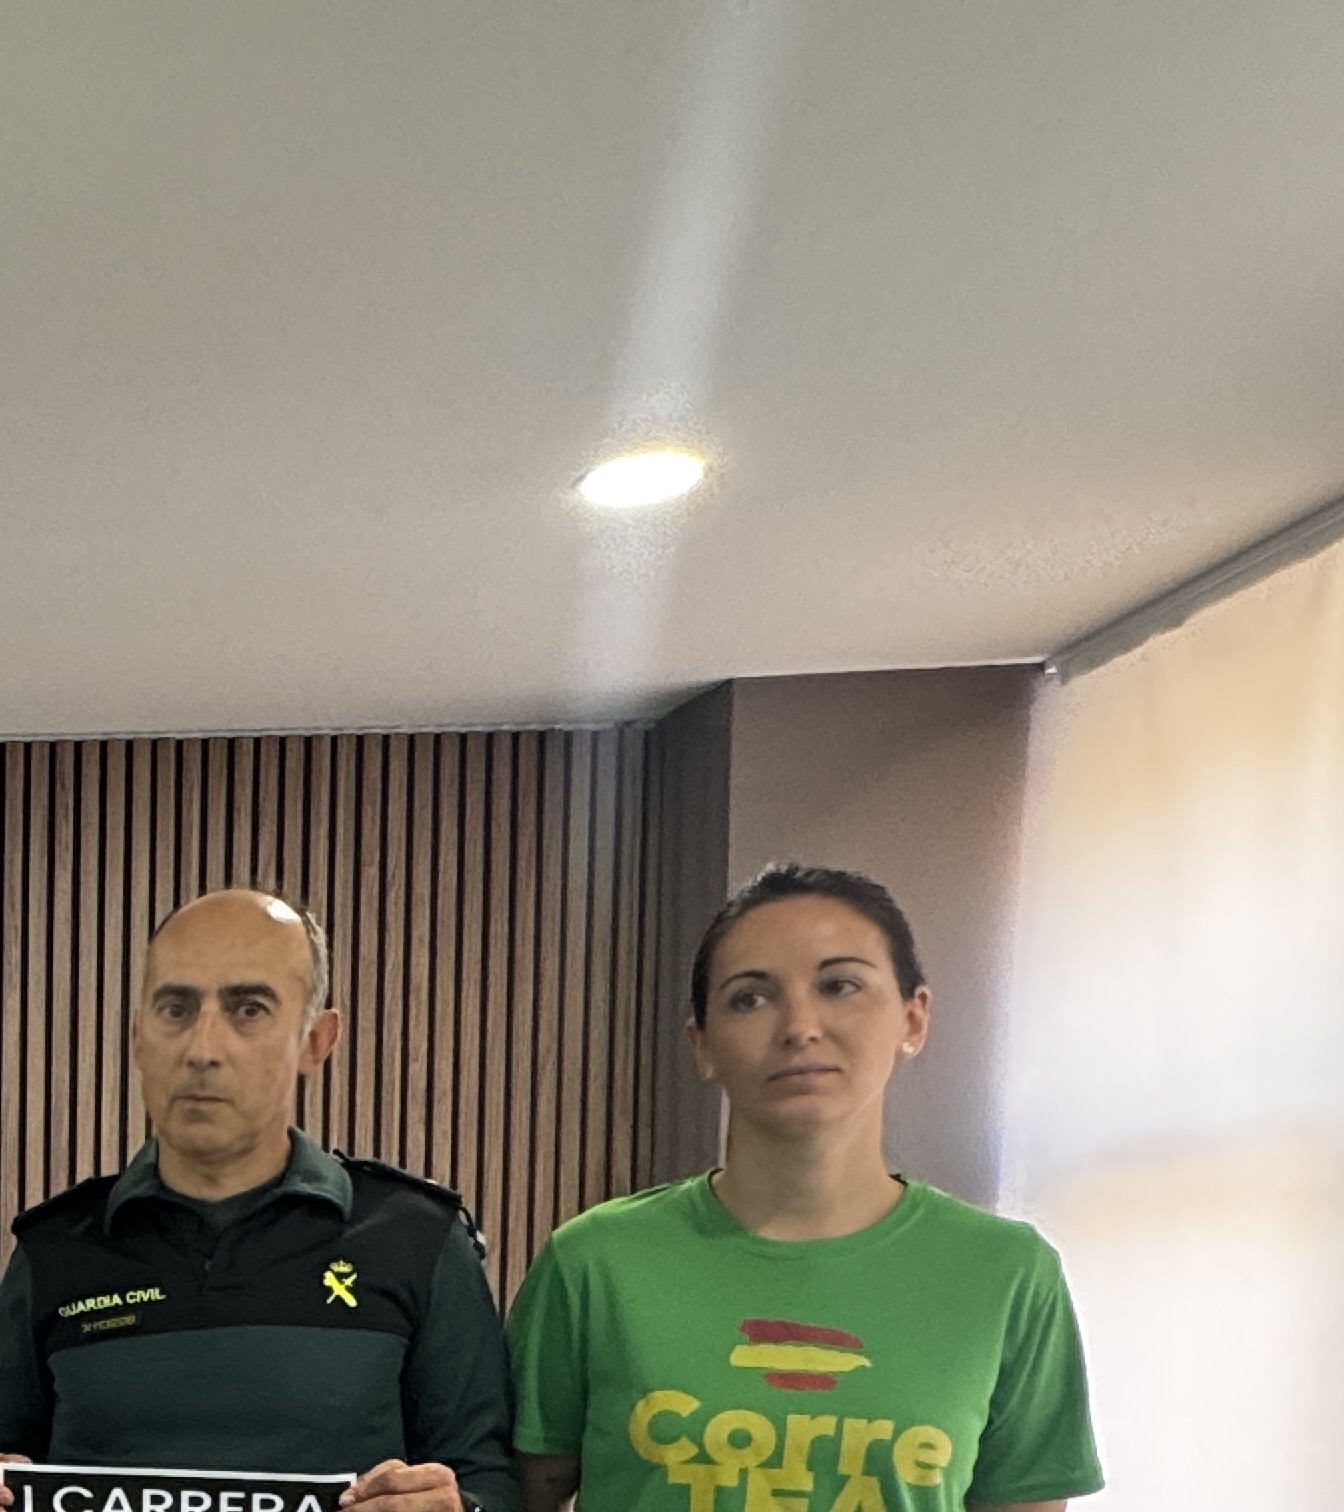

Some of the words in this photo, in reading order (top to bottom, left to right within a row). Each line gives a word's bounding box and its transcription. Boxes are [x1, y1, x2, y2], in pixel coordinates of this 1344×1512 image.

[58, 1293, 123, 1318] GUARDIA
[126, 1287, 166, 1304] CIVIL
[628, 1389, 953, 1487] Corre
